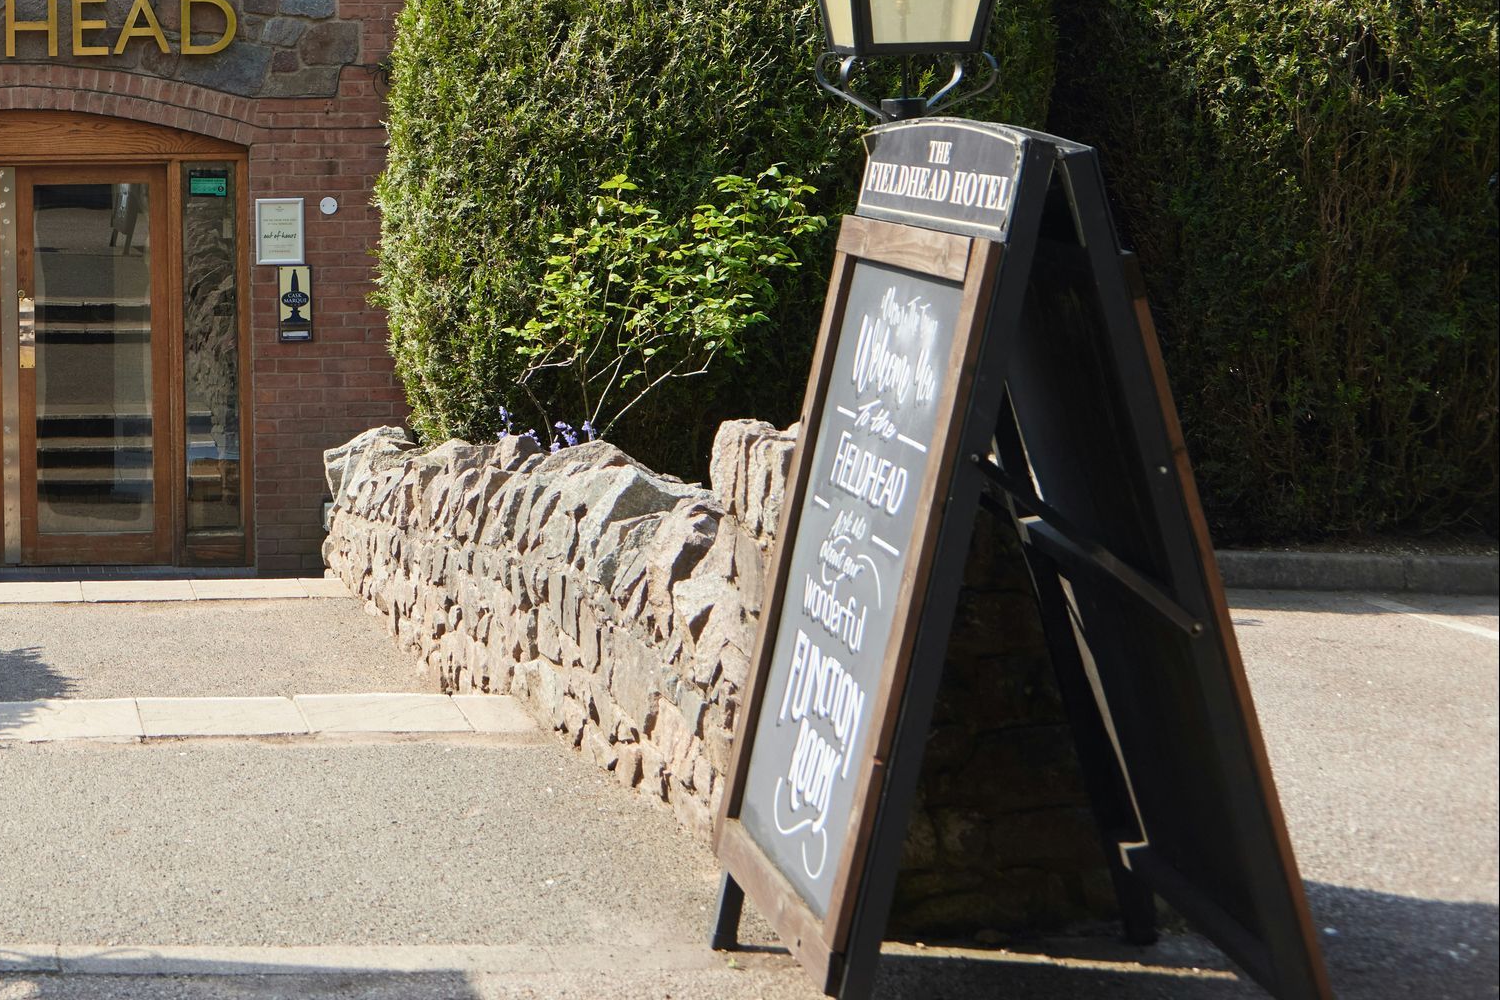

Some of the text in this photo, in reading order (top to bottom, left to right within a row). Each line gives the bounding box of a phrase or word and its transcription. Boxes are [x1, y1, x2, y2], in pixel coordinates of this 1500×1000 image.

[866, 161, 1009, 211] FIELDHEAD HOTEL
[928, 140, 952, 165] THE
[852, 314, 911, 404] Welcome
[854, 400, 896, 438] To the
[830, 430, 908, 515] FIELDHEAD
[803, 573, 867, 652] wonderful
[779, 628, 865, 779] FUNCTION
[788, 717, 841, 833] ROOMS
